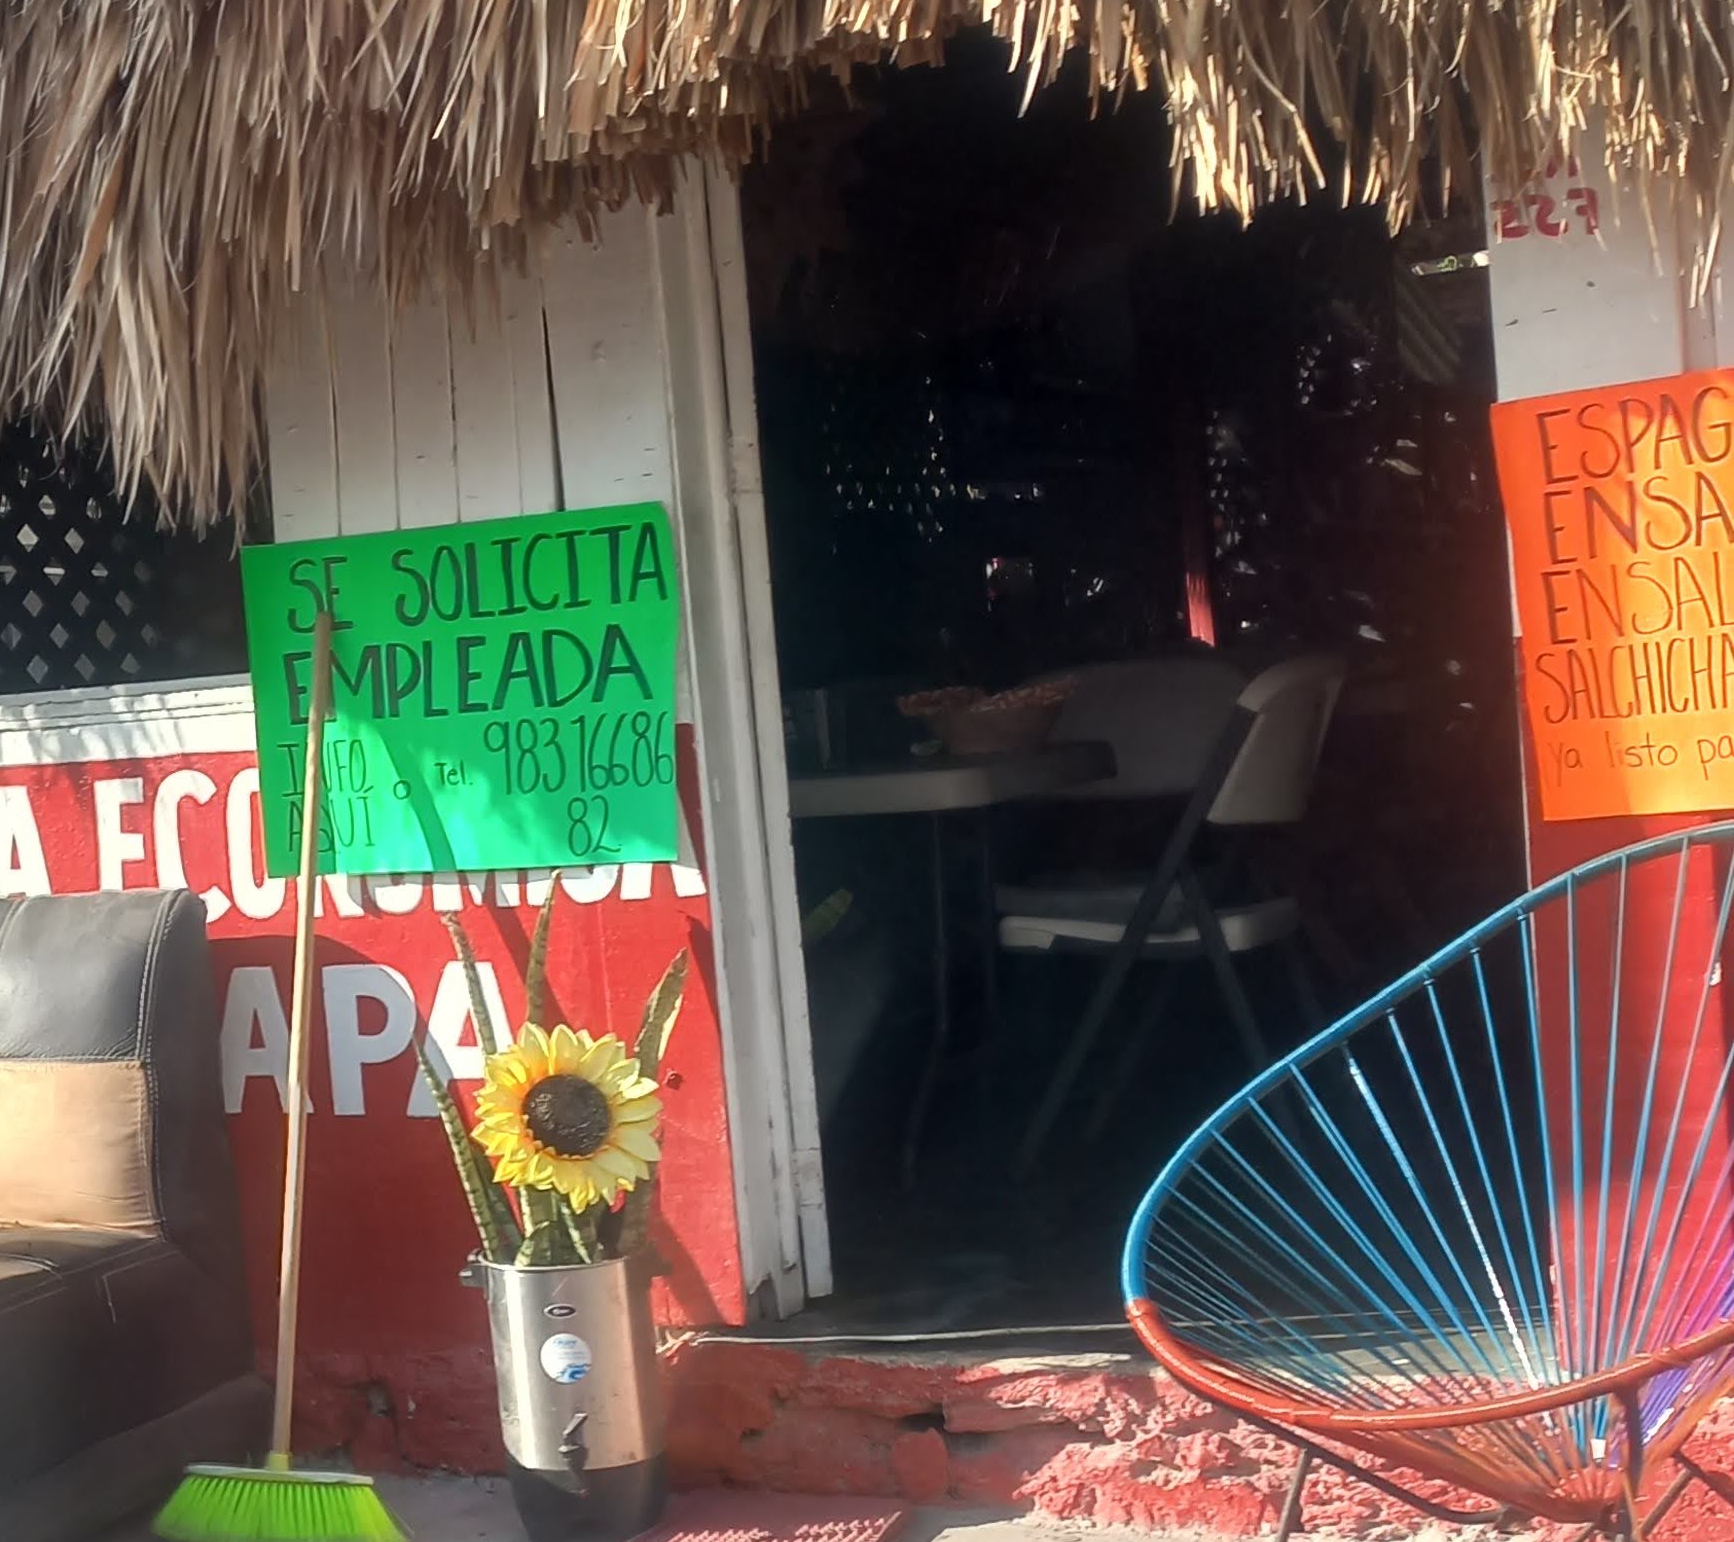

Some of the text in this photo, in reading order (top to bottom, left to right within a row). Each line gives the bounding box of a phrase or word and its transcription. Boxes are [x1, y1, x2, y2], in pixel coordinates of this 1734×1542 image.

[286, 520, 669, 635] SE SOLICITA
[281, 623, 655, 726] EMPLEADA
[433, 759, 474, 787] Tel.
[567, 794, 622, 858] 82
